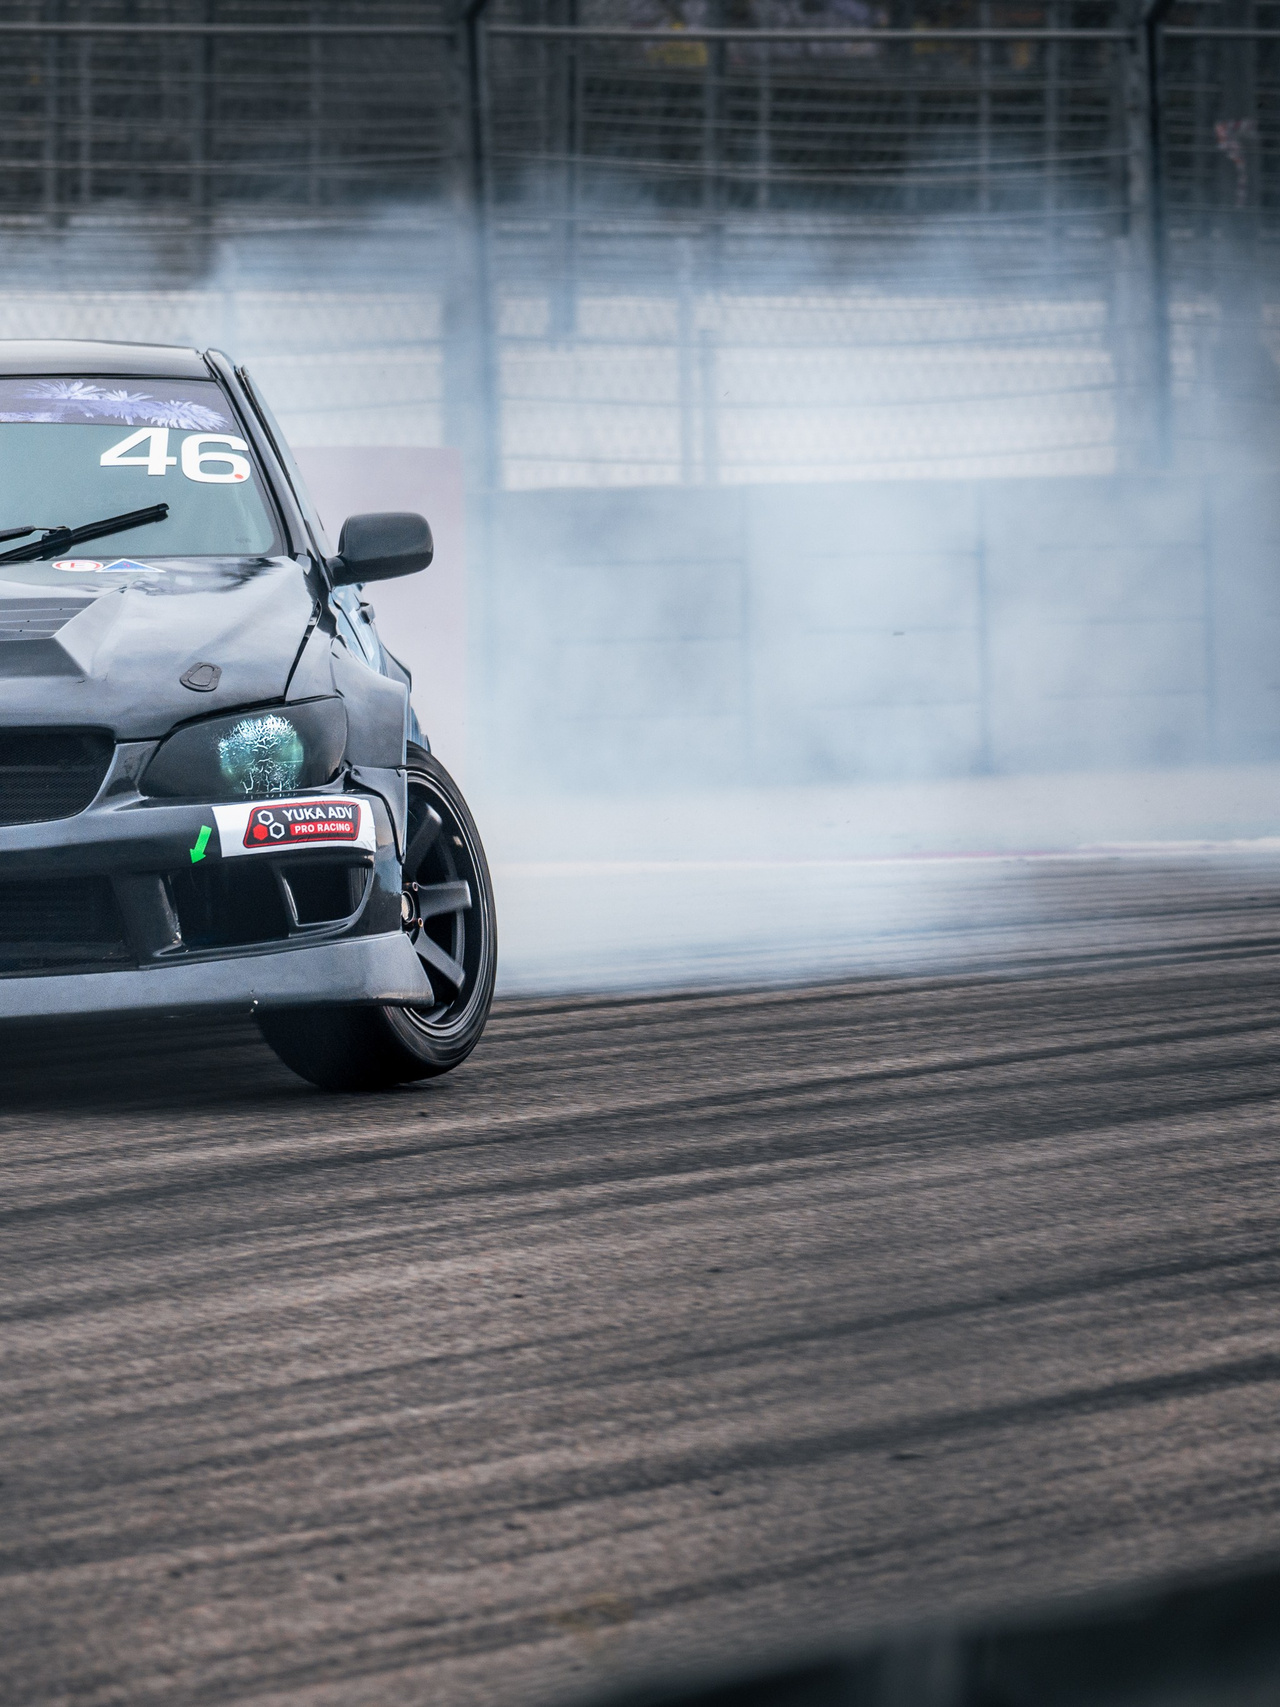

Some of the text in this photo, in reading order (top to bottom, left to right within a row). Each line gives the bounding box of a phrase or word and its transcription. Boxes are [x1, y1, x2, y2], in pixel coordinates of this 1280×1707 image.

[100, 427, 251, 484] 46
[282, 806, 353, 821] YUKA ADV
[294, 822, 351, 834] PRO RACING
